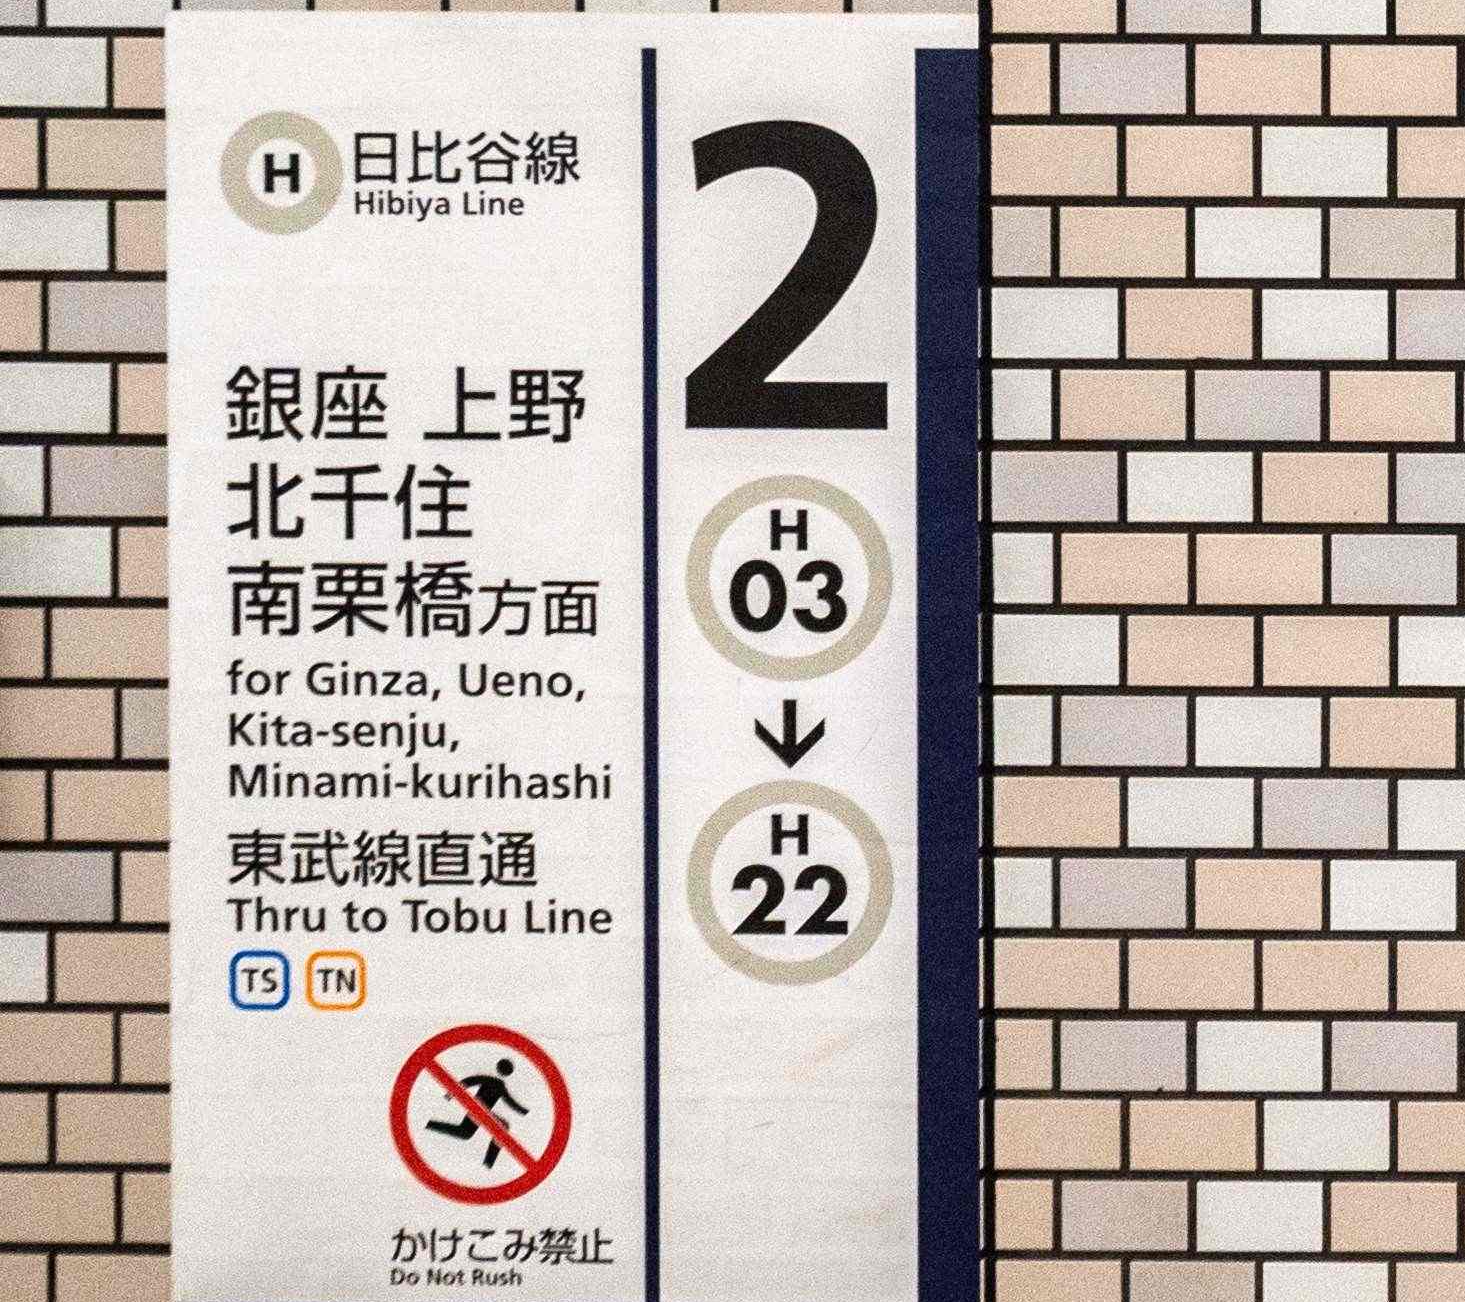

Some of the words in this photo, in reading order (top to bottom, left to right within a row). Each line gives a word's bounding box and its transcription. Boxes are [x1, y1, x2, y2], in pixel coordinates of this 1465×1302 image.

[264, 153, 300, 193] H
[354, 130, 580, 185] 日比谷線
[354, 190, 451, 222] Hibiya
[463, 192, 525, 216] Line
[685, 120, 888, 430] 2
[226, 364, 388, 441] 銀座
[423, 366, 586, 443] 上野
[227, 462, 473, 540] 北千住
[770, 509, 808, 551] H
[227, 560, 599, 638] 南栗橋方面
[729, 559, 847, 633] 03
[227, 659, 291, 696] for
[306, 660, 441, 702] Ginza,
[459, 663, 585, 703] Ueno,
[229, 711, 460, 755] Kita-senju,
[229, 762, 611, 800] Minami-kurihashi
[771, 814, 809, 855] H
[228, 829, 537, 888] 東武線直通
[227, 896, 326, 934] Thru
[342, 901, 387, 934] to
[402, 897, 506, 935] Tobu
[525, 899, 612, 935] Line
[732, 864, 848, 936] 22
[243, 968, 279, 994] TS
[318, 968, 356, 994] TN
[391, 1227, 614, 1266] かけこみ禁止
[390, 1267, 420, 1286] Do
[426, 1268, 465, 1286] Not
[472, 1268, 523, 1286] Rush
